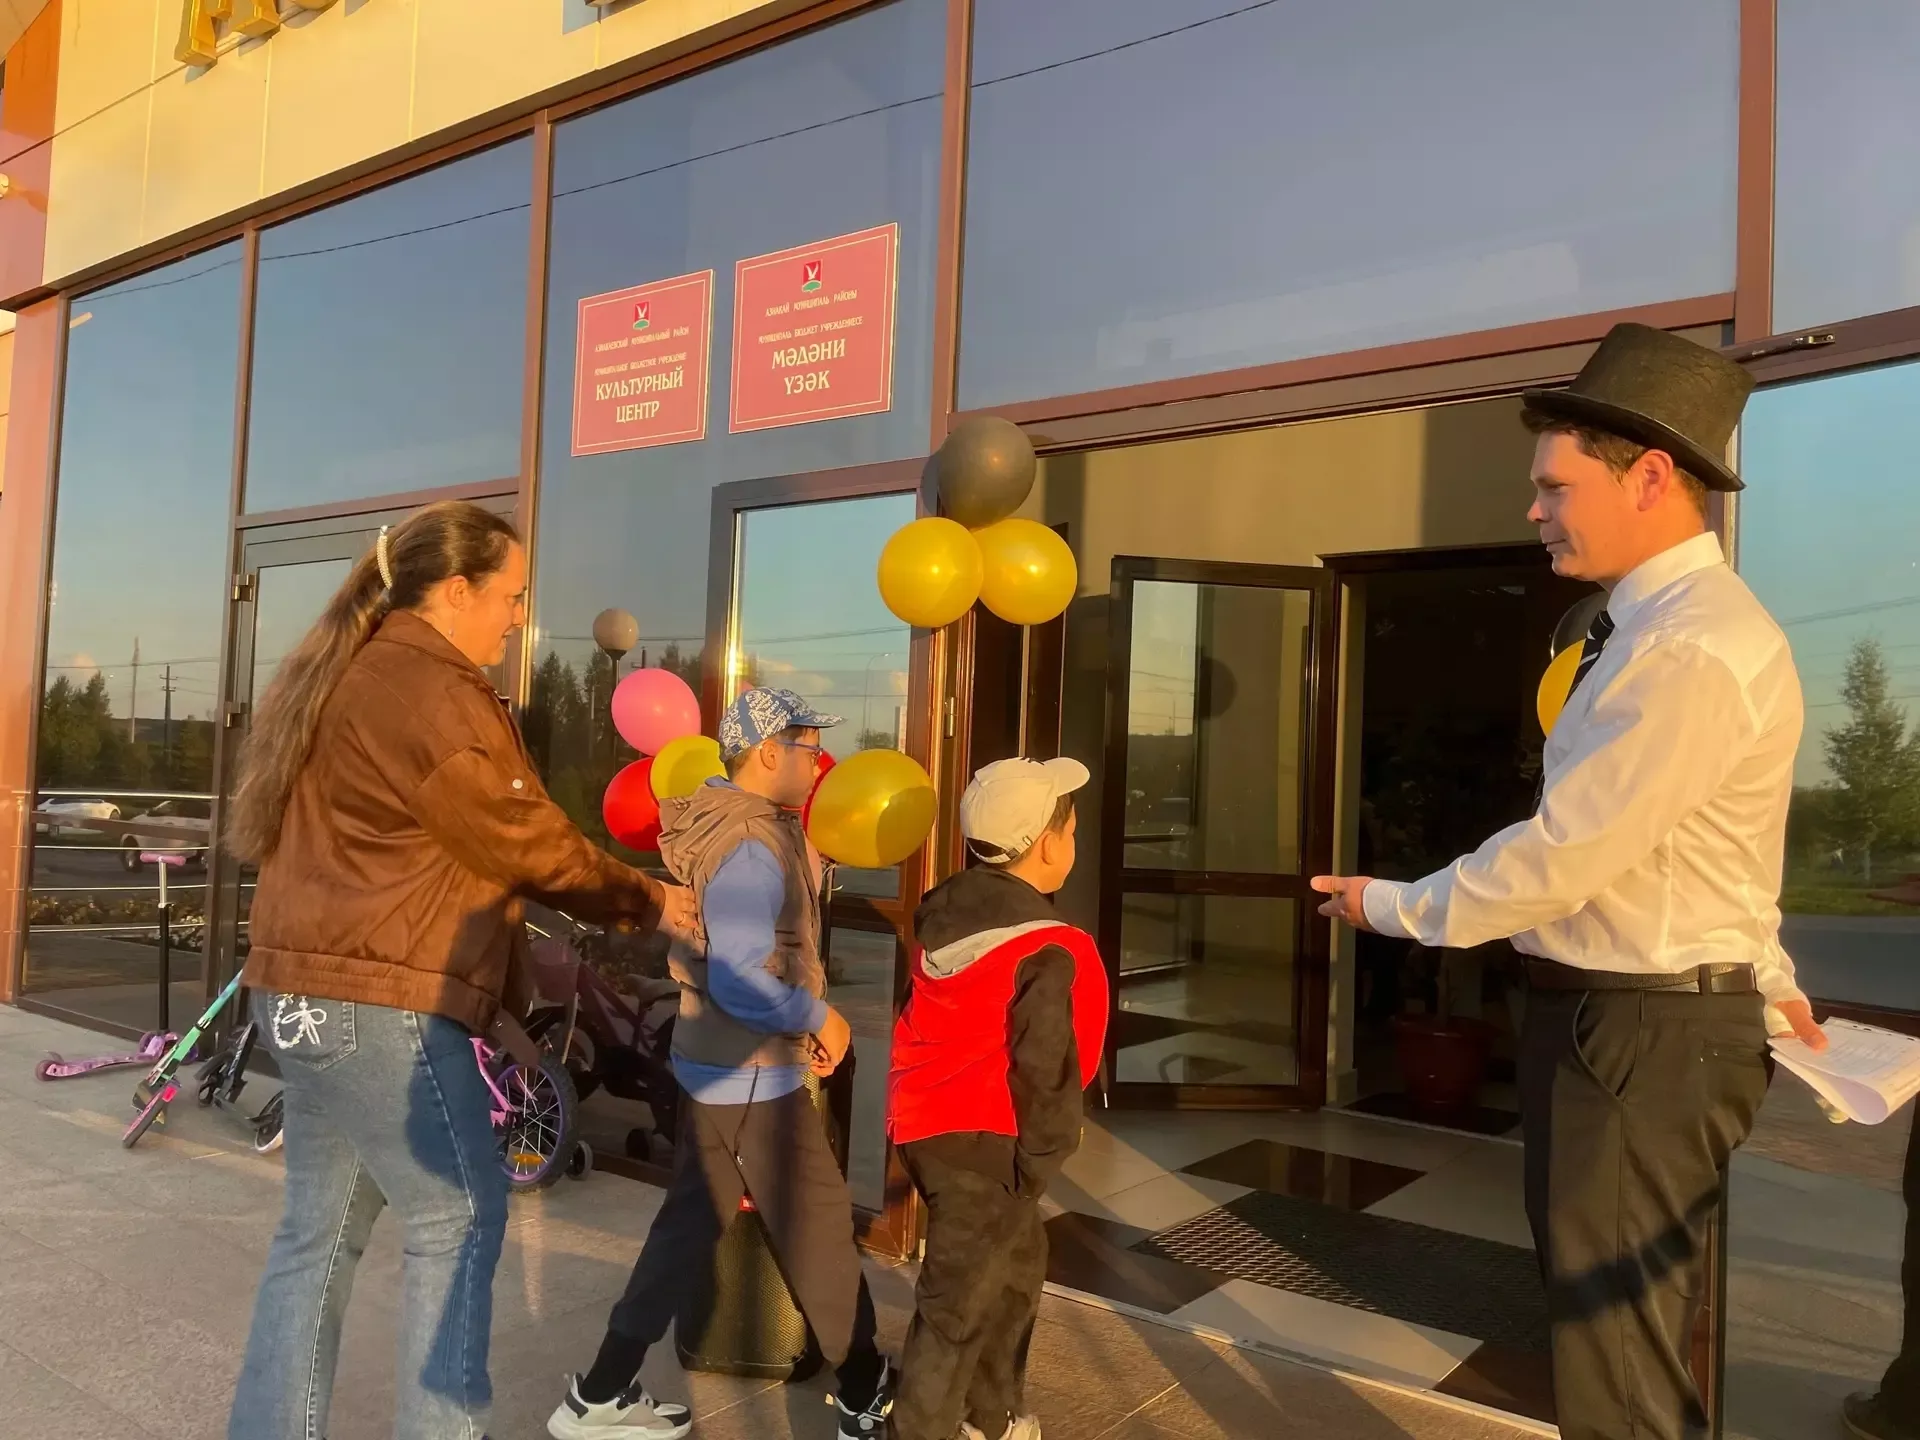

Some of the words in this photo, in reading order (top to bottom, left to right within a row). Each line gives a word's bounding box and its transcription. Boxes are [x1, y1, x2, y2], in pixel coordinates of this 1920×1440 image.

[771, 338, 846, 369] МӘДӘНИ
[596, 366, 684, 401] КУЛЬТУРНЫЙ
[784, 370, 830, 395] ҮЗӘК
[616, 400, 660, 423] ЦЕНТР
